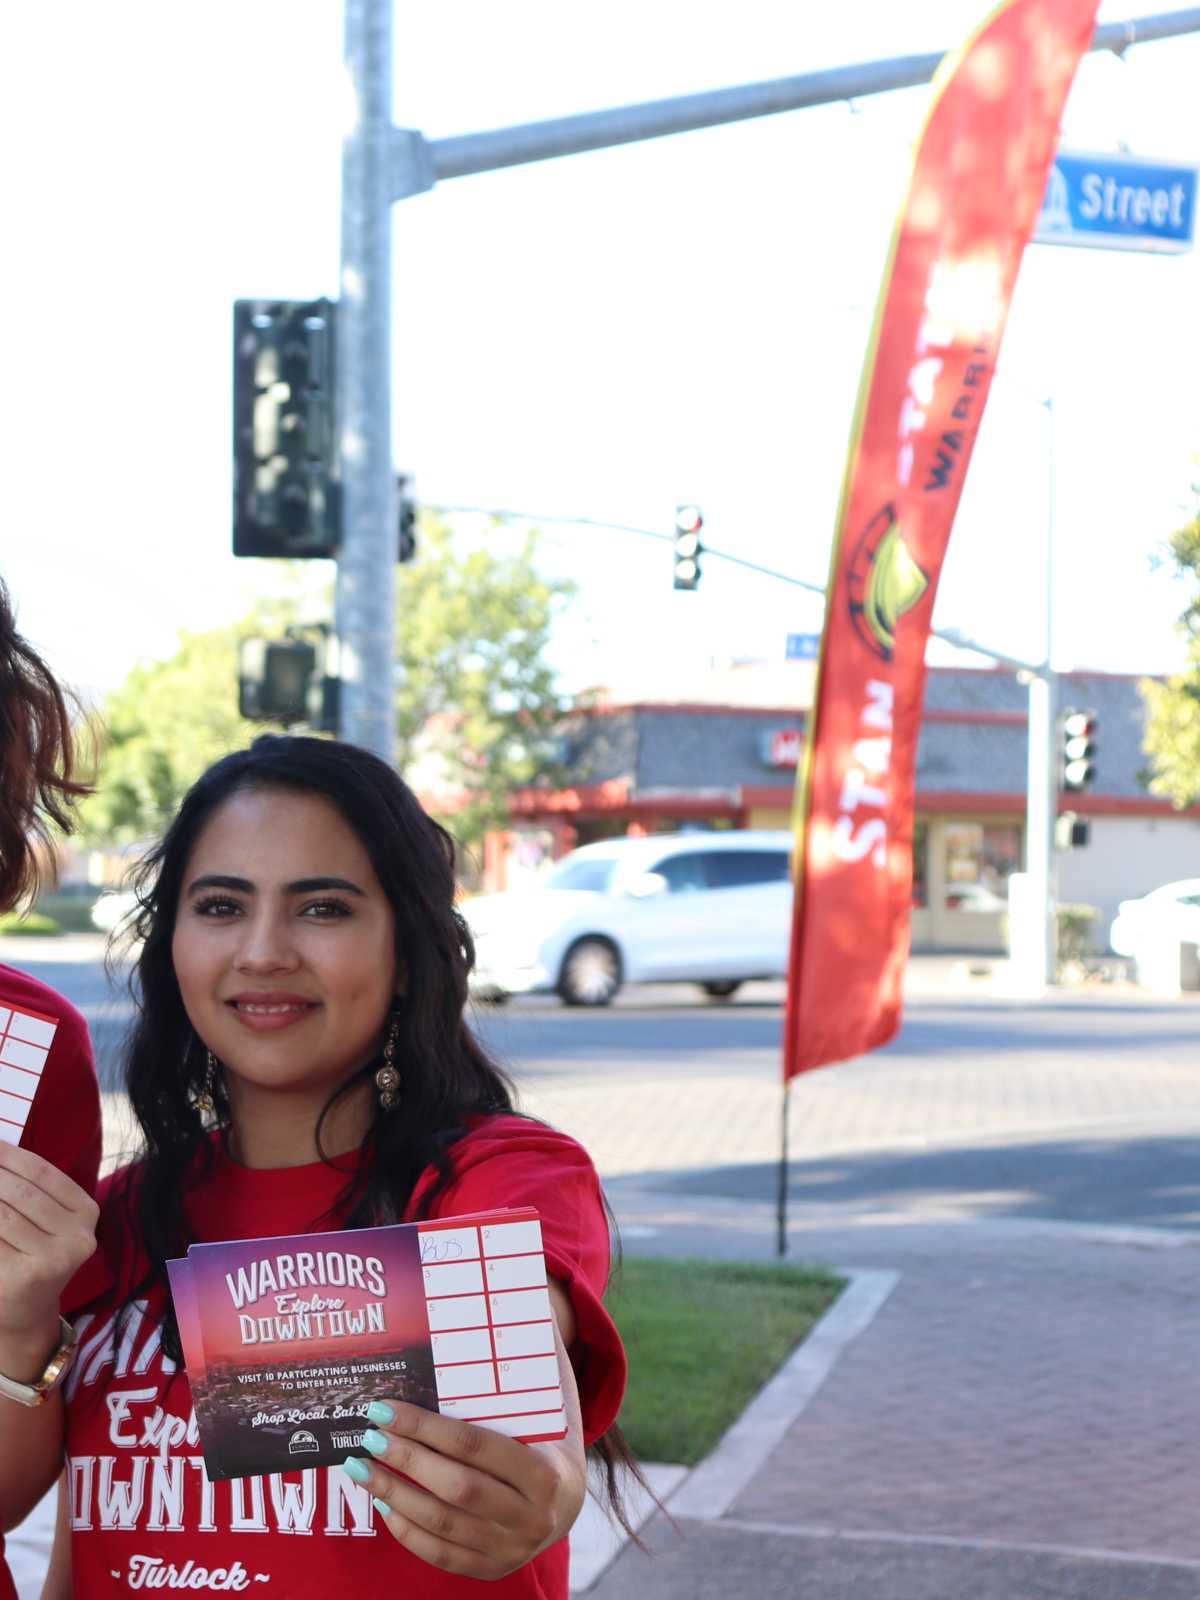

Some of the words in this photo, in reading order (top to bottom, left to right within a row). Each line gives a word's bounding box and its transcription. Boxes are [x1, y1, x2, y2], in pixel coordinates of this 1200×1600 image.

[1081, 172, 1187, 228] Street
[831, 678, 895, 869] STAN
[225, 1252, 387, 1310] WARRIORS
[238, 1302, 387, 1345] DOWNTOWN
[275, 1293, 346, 1318] Explore
[237, 1373, 262, 1384] VISIT
[265, 1372, 275, 1381] 10
[277, 1365, 348, 1381] PARTICIPATING
[351, 1361, 407, 1375] BUSINESSES
[280, 1381, 294, 1391] TO
[296, 1379, 325, 1389] ENTER
[326, 1376, 359, 1387] RAFFLE
[500, 1363, 511, 1373] 10
[105, 1386, 201, 1468] Expl
[252, 1411, 287, 1428] Shop
[287, 1406, 330, 1425] Local.
[332, 1404, 356, 1418] Eat
[66, 1455, 377, 1537] OWNTOWN
